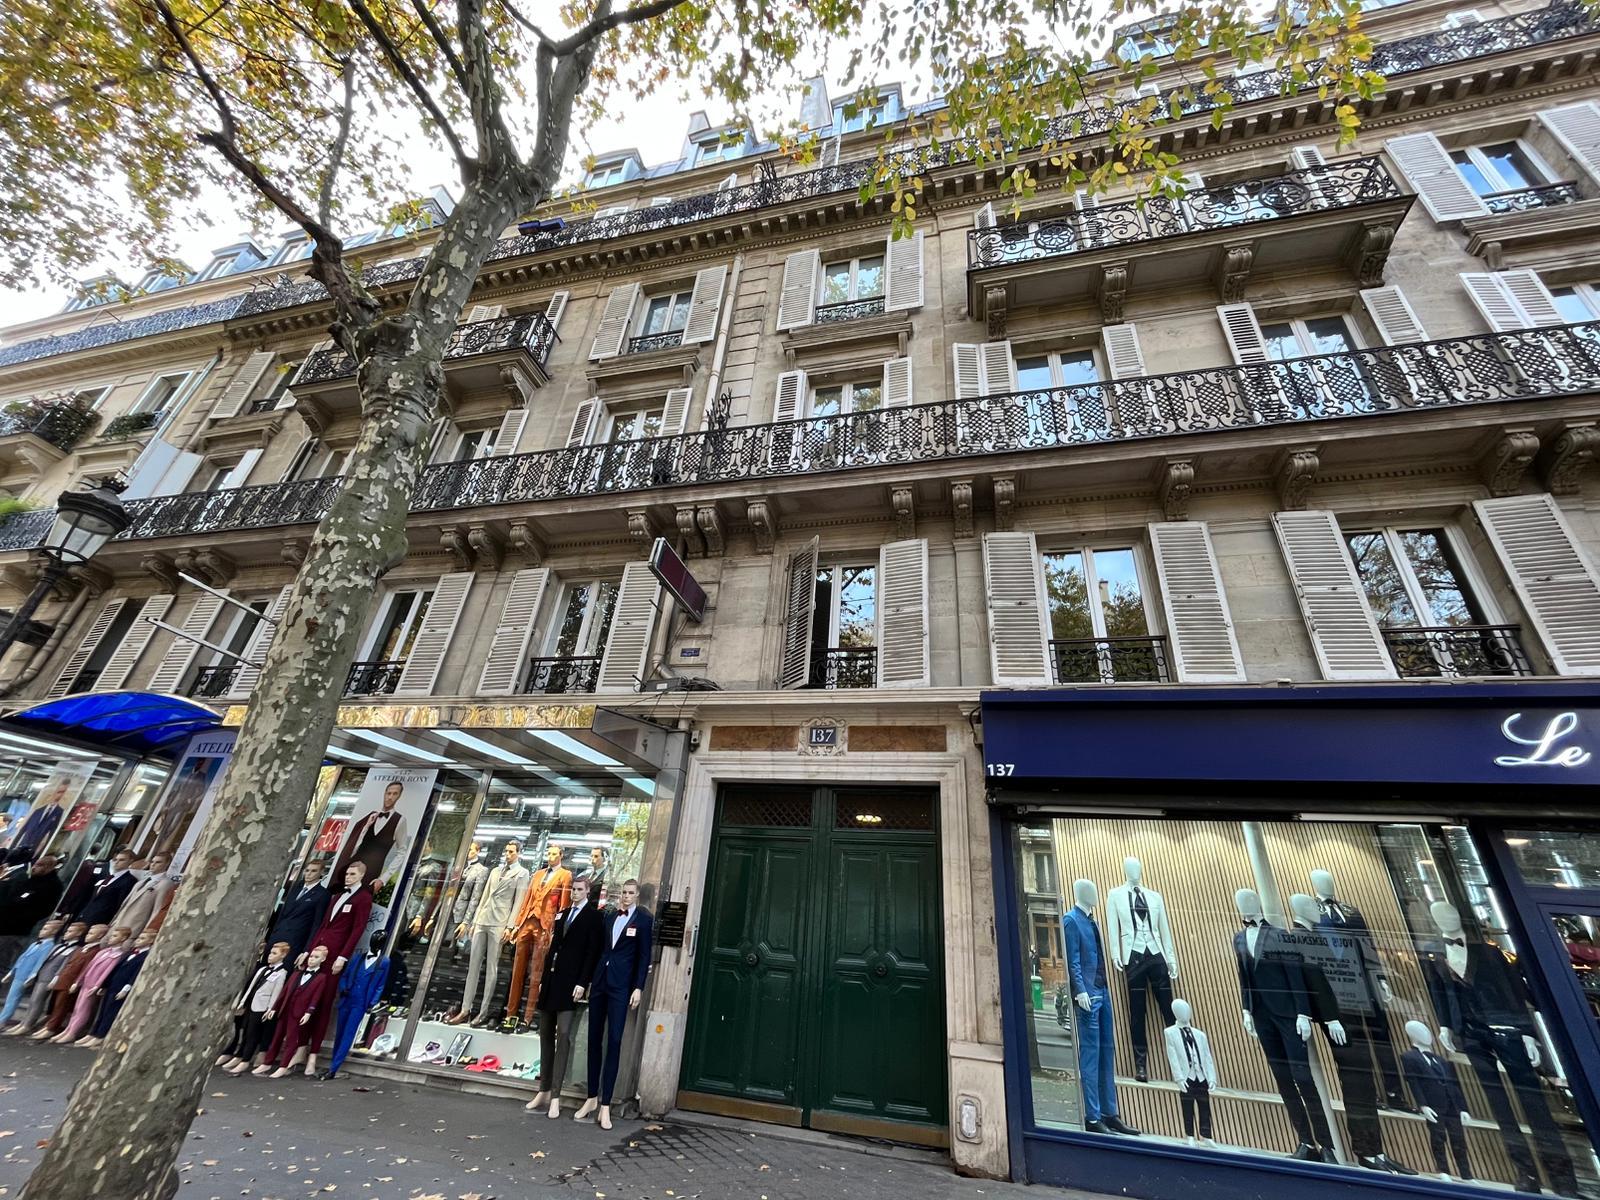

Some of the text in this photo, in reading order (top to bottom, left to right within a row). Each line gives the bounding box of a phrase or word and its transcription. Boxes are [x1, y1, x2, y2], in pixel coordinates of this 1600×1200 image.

[811, 728, 834, 742] 137
[1494, 711, 1591, 767] Le
[193, 742, 233, 753] ATELIE
[987, 763, 1015, 776] 137
